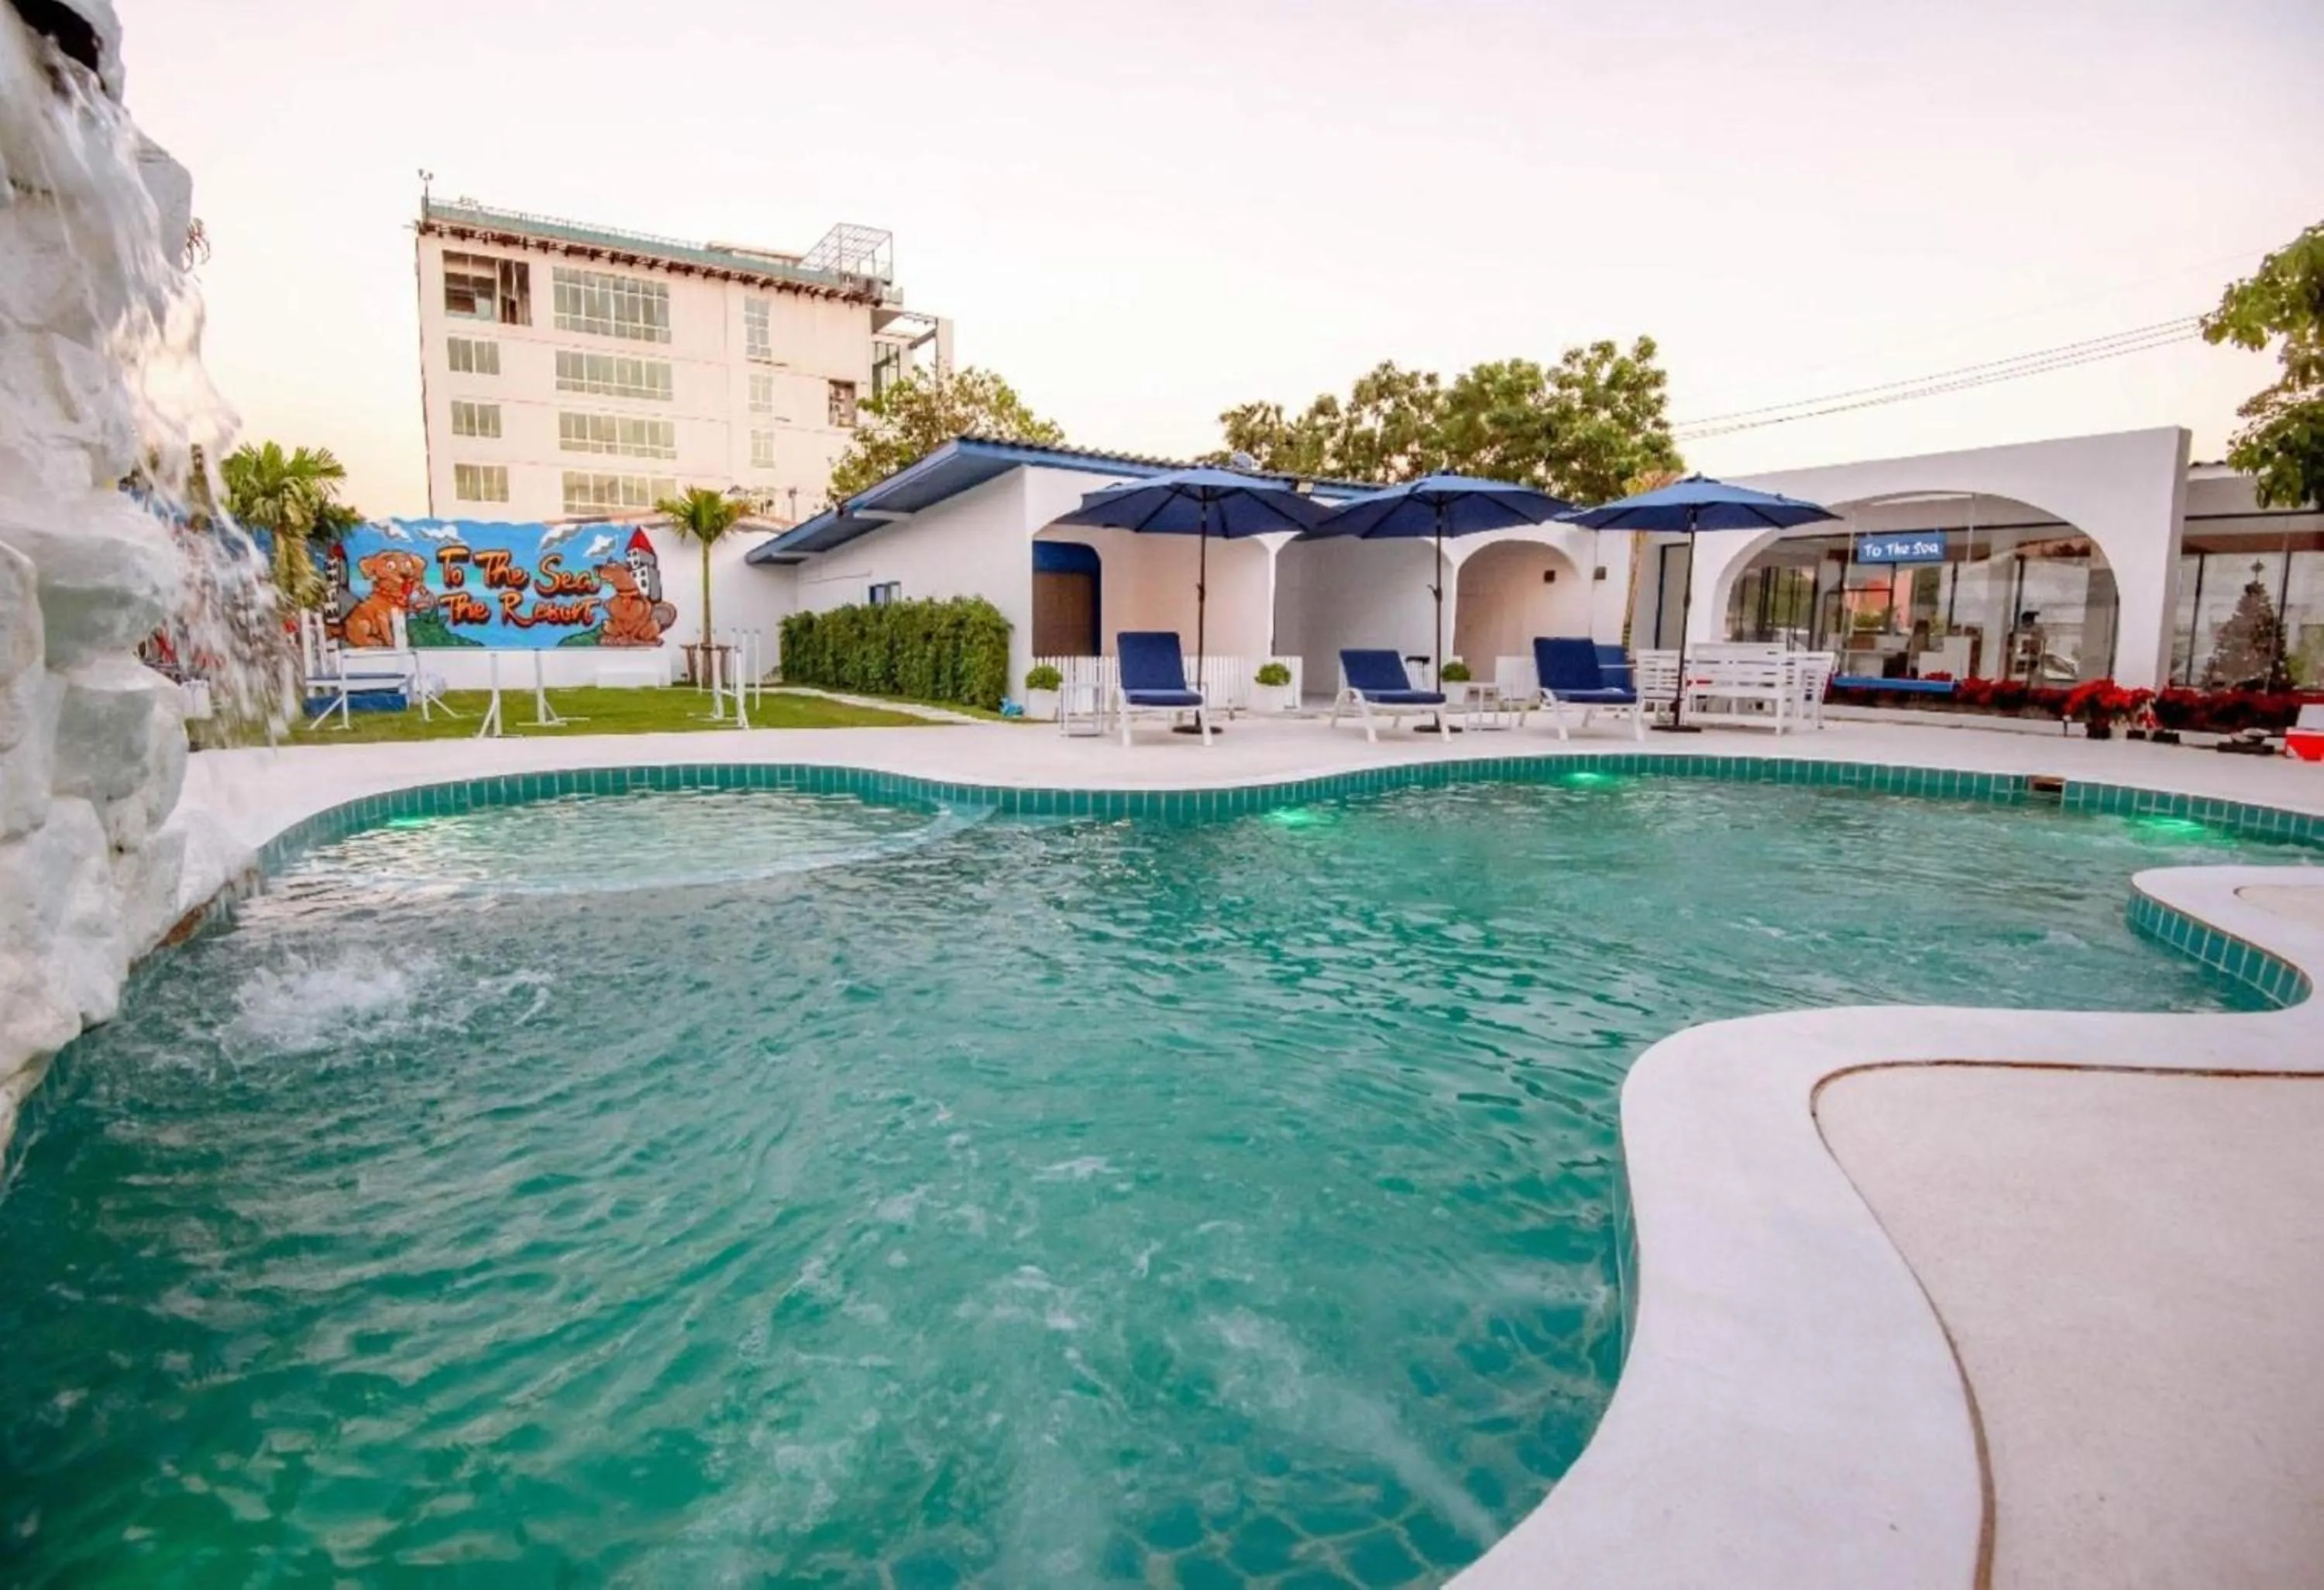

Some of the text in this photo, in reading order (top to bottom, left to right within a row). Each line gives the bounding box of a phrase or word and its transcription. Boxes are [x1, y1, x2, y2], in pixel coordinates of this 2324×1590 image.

[1863, 543, 1882, 557] To
[1885, 542, 1910, 556] The
[437, 545, 601, 597] To The Sea
[439, 591, 491, 625] The
